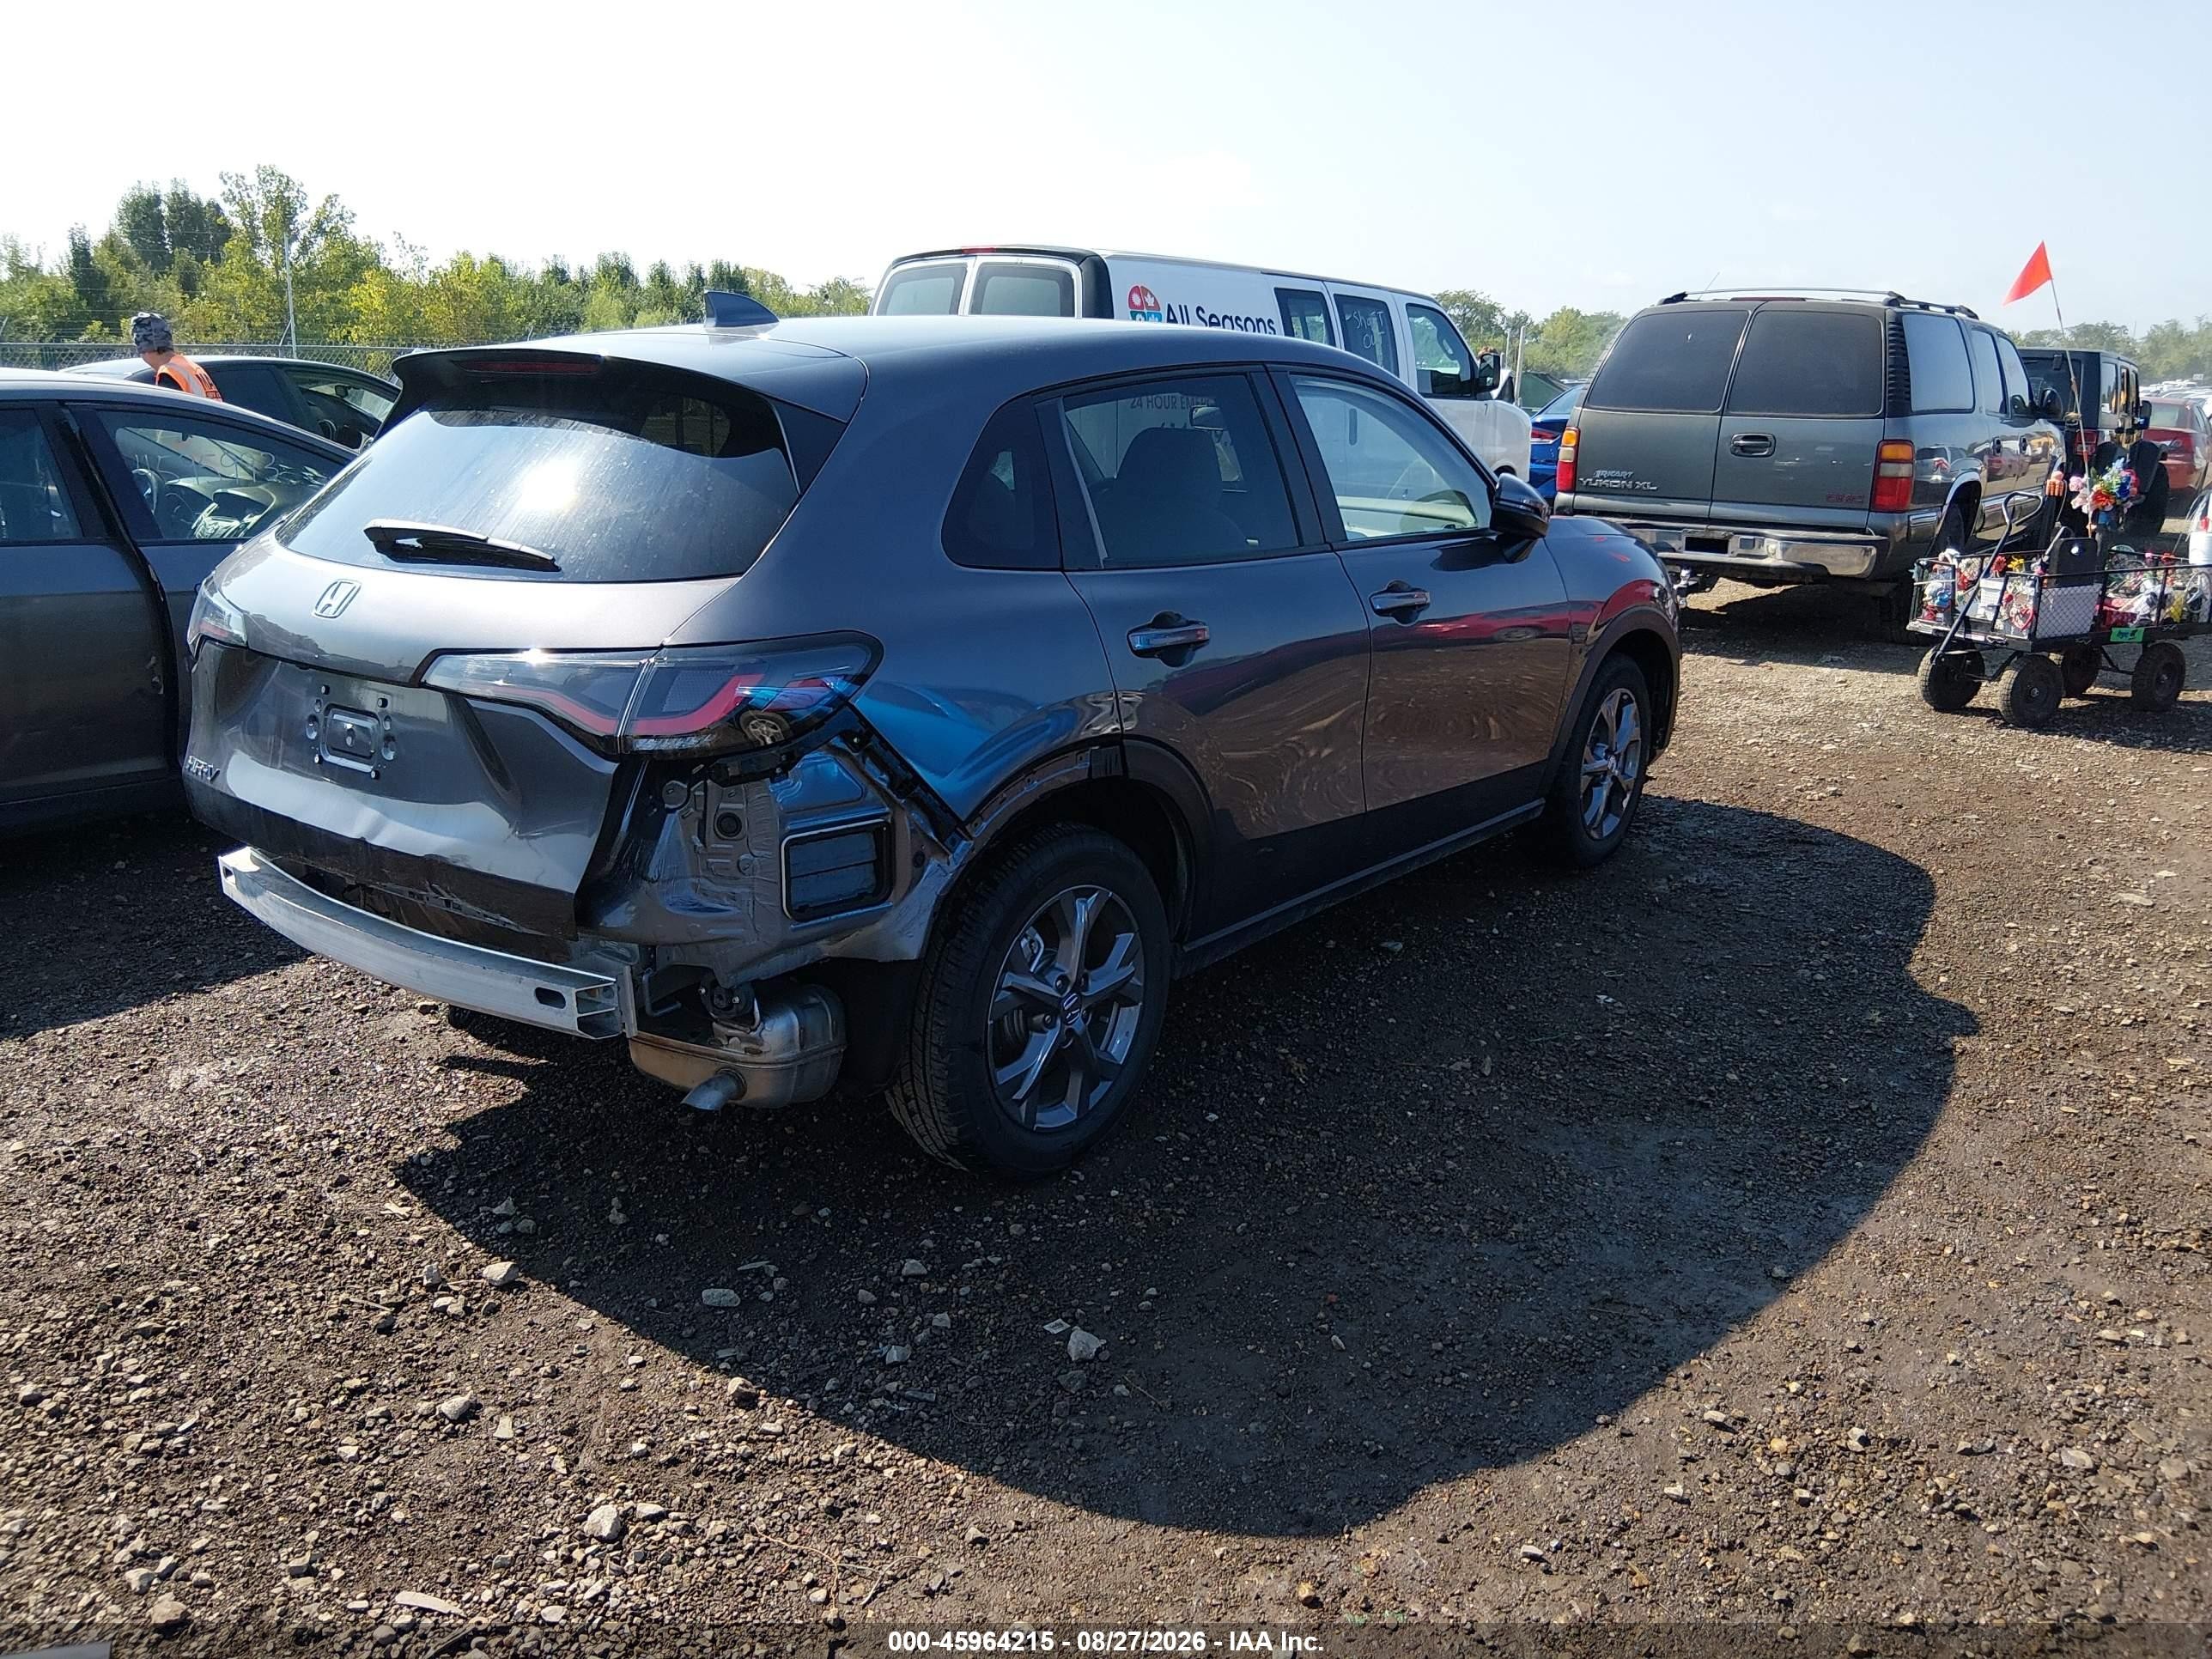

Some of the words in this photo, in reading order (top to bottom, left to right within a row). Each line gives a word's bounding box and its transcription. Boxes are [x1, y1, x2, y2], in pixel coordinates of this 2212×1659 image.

[1166, 303, 1190, 325] All
[1195, 306, 1276, 335] Seasons
[1130, 398, 1142, 409] 24
[1146, 395, 1177, 409] HOUR
[1578, 477, 1632, 489] YUKON
[1634, 482, 1658, 490] XL
